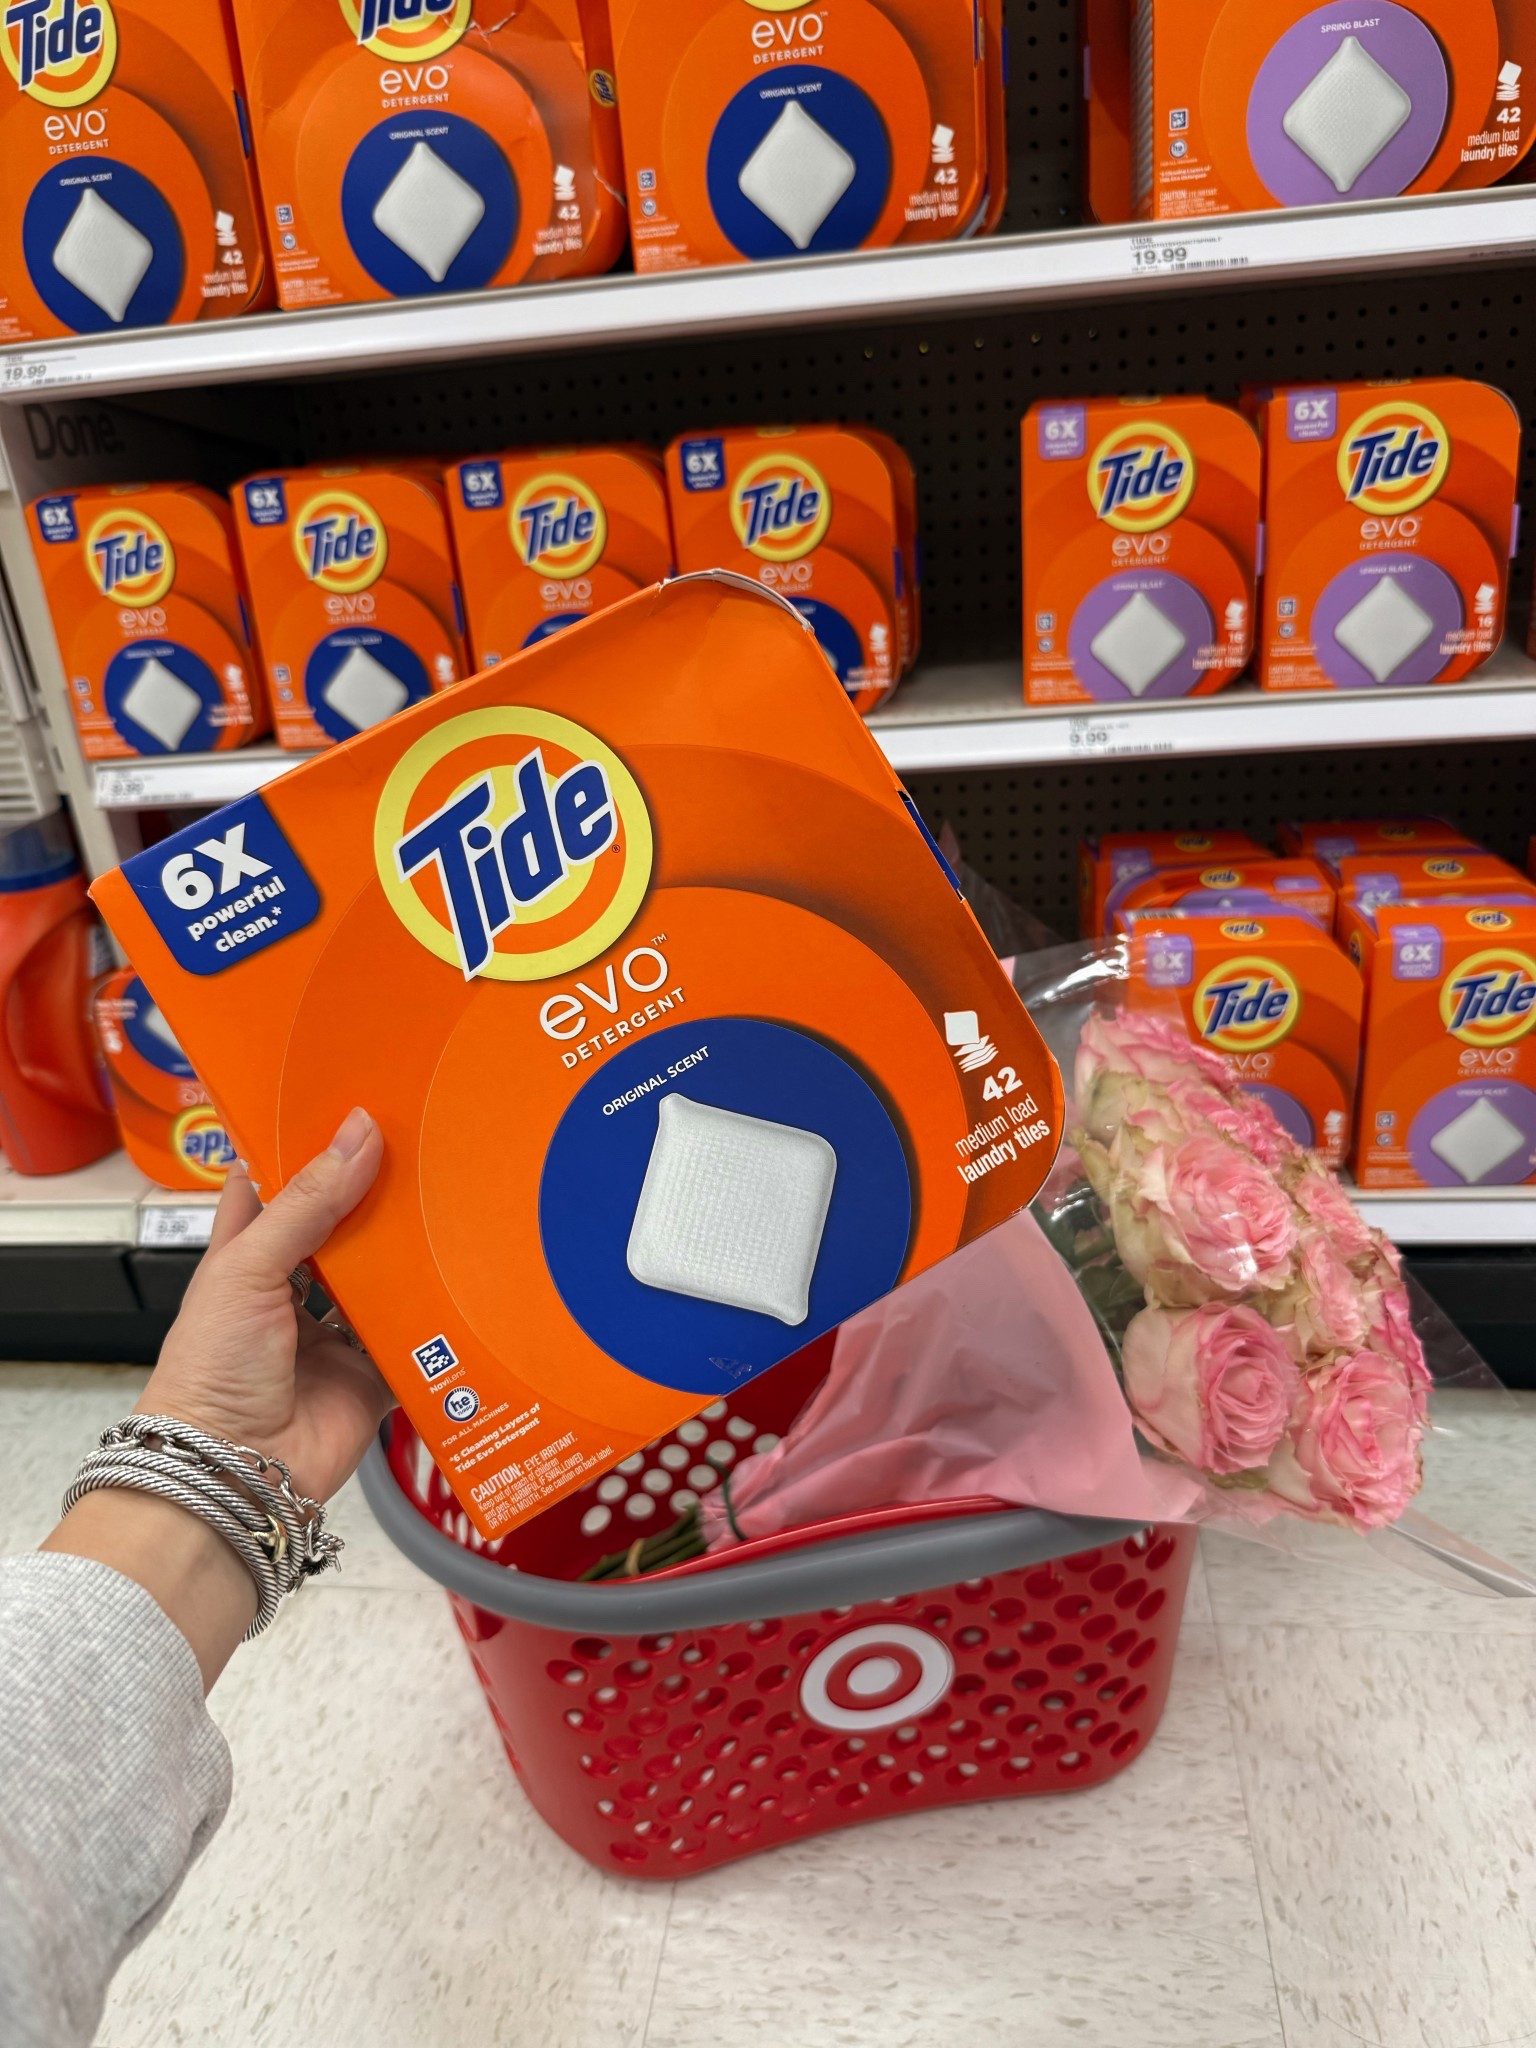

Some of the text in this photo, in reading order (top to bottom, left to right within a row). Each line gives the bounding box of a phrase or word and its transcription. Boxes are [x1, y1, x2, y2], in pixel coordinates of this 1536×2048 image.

[751, 13, 823, 49] evo
[1321, 18, 1380, 34] SPRING BLAST
[5, 0, 103, 91] Tide
[753, 45, 824, 65] DETERGENT
[379, 65, 449, 94] evo
[382, 93, 449, 109] DETERGENT
[44, 110, 106, 141] evo
[1496, 106, 1521, 124] 42
[49, 139, 109, 156] DETERGENT
[1467, 126, 1520, 147] medium load
[1460, 143, 1518, 163] laundry tiles
[933, 167, 958, 185] 42
[557, 205, 581, 221] 42
[221, 249, 244, 266] 42
[1133, 247, 1187, 266] 19.99
[5, 364, 47, 381] 19.99
[1294, 398, 1329, 421] 6X
[1045, 418, 1078, 441] 6X
[686, 452, 719, 473] 6X
[1345, 425, 1440, 502] Tide
[465, 472, 496, 492] 6X
[1097, 445, 1185, 519] Tide
[249, 488, 280, 508] 6X
[41, 507, 71, 526] 6X
[740, 476, 820, 549] Tide
[518, 497, 596, 566] Tide
[1360, 517, 1420, 540] evo
[301, 514, 377, 580] Tide
[1111, 533, 1169, 557] evo
[93, 531, 166, 596] Tide
[759, 560, 813, 585] evo
[539, 578, 593, 601] evo
[119, 606, 167, 629] evo
[325, 593, 375, 616] evo
[162, 822, 273, 911] 6X
[393, 745, 619, 983] Tide
[187, 875, 287, 942] powerful
[1399, 942, 1434, 963] 6X
[1202, 976, 1291, 1040] Tide
[1446, 970, 1536, 1033] Tide
[560, 987, 685, 1069] DETERGENT
[1459, 1047, 1515, 1067] evo
[602, 1045, 711, 1116] ORIGINAL SCENT
[982, 1066, 1023, 1102] 42
[955, 1093, 1039, 1157] medium load
[957, 1119, 1051, 1185] laundry tiles
[429, 1368, 466, 1394] NaviLens
[450, 1395, 471, 1412] he
[441, 1402, 510, 1447] FOR ALL MACHINES
[460, 1430, 500, 1457] Cleaning
[498, 1411, 529, 1434] Layers
[529, 1402, 540, 1414] of
[454, 1417, 540, 1473] Tide Evo Detergent
[470, 1431, 578, 1503] CAUTION: EYE IRRITANT.
[510, 1481, 541, 1504] HARMFUL
[546, 1452, 584, 1481] SWALLOWED
[477, 1499, 495, 1512] Keep
[511, 1477, 529, 1492] reach
[534, 1457, 560, 1477] children
[541, 1483, 555, 1496] See
[553, 1470, 576, 1489] caution
